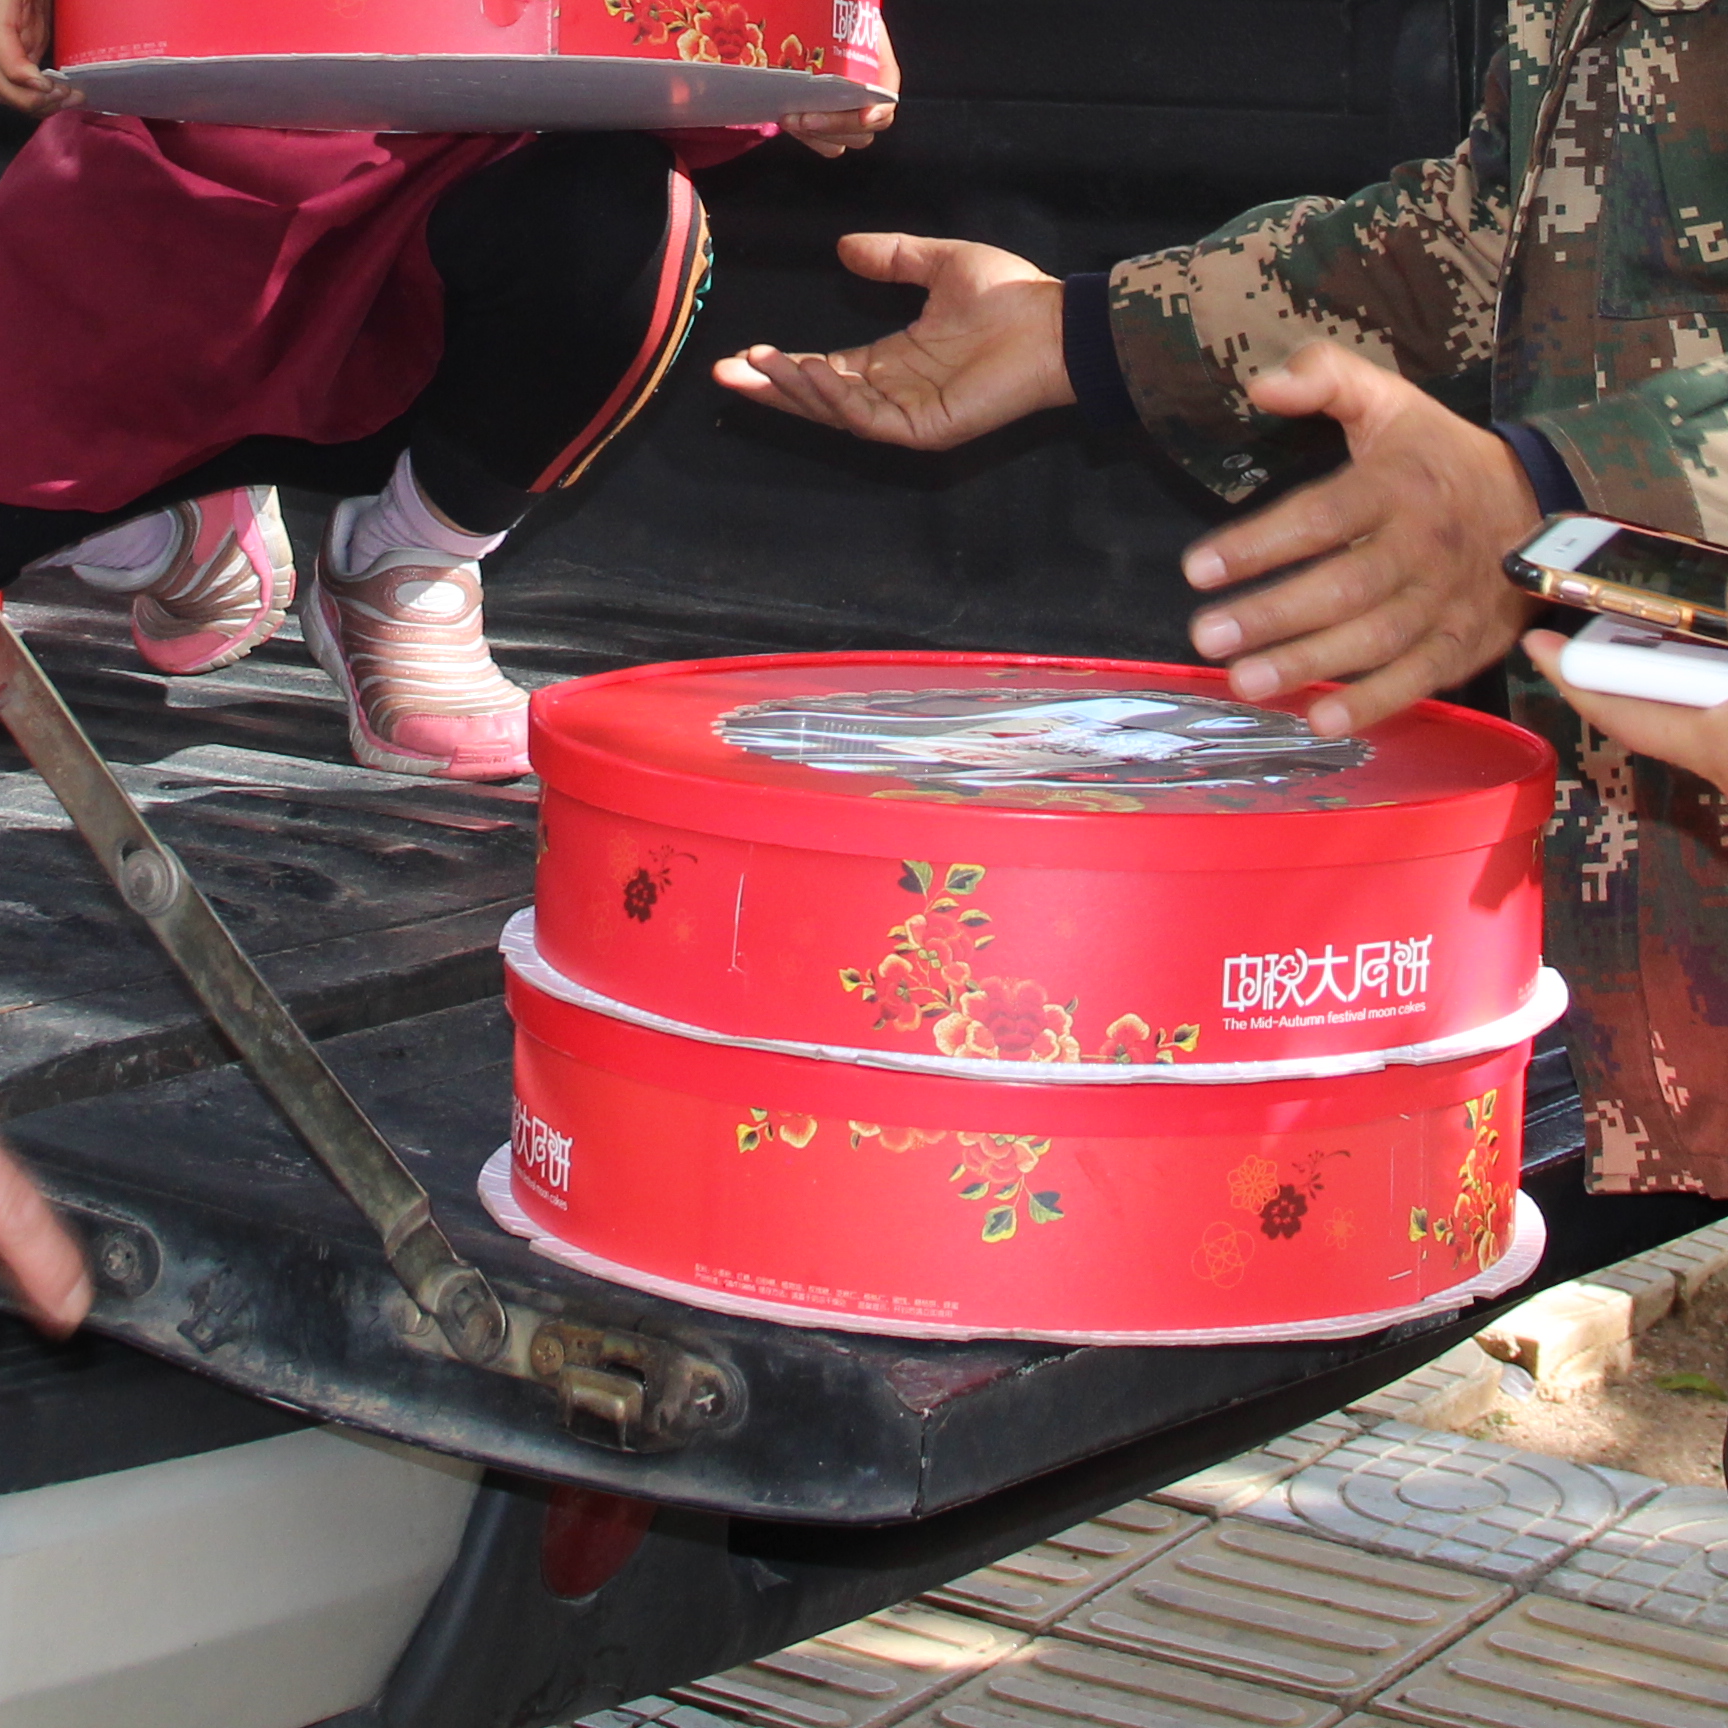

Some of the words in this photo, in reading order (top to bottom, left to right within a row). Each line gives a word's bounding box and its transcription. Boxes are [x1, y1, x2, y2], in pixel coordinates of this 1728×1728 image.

[1222, 934, 1433, 1012] 中秋大月饼
[1223, 1017, 1248, 1030] The
[1250, 1013, 1325, 1029] Mid-Autumn
[1327, 1007, 1366, 1025] festival
[1368, 1005, 1397, 1020] moon
[1398, 1001, 1426, 1016] cakes
